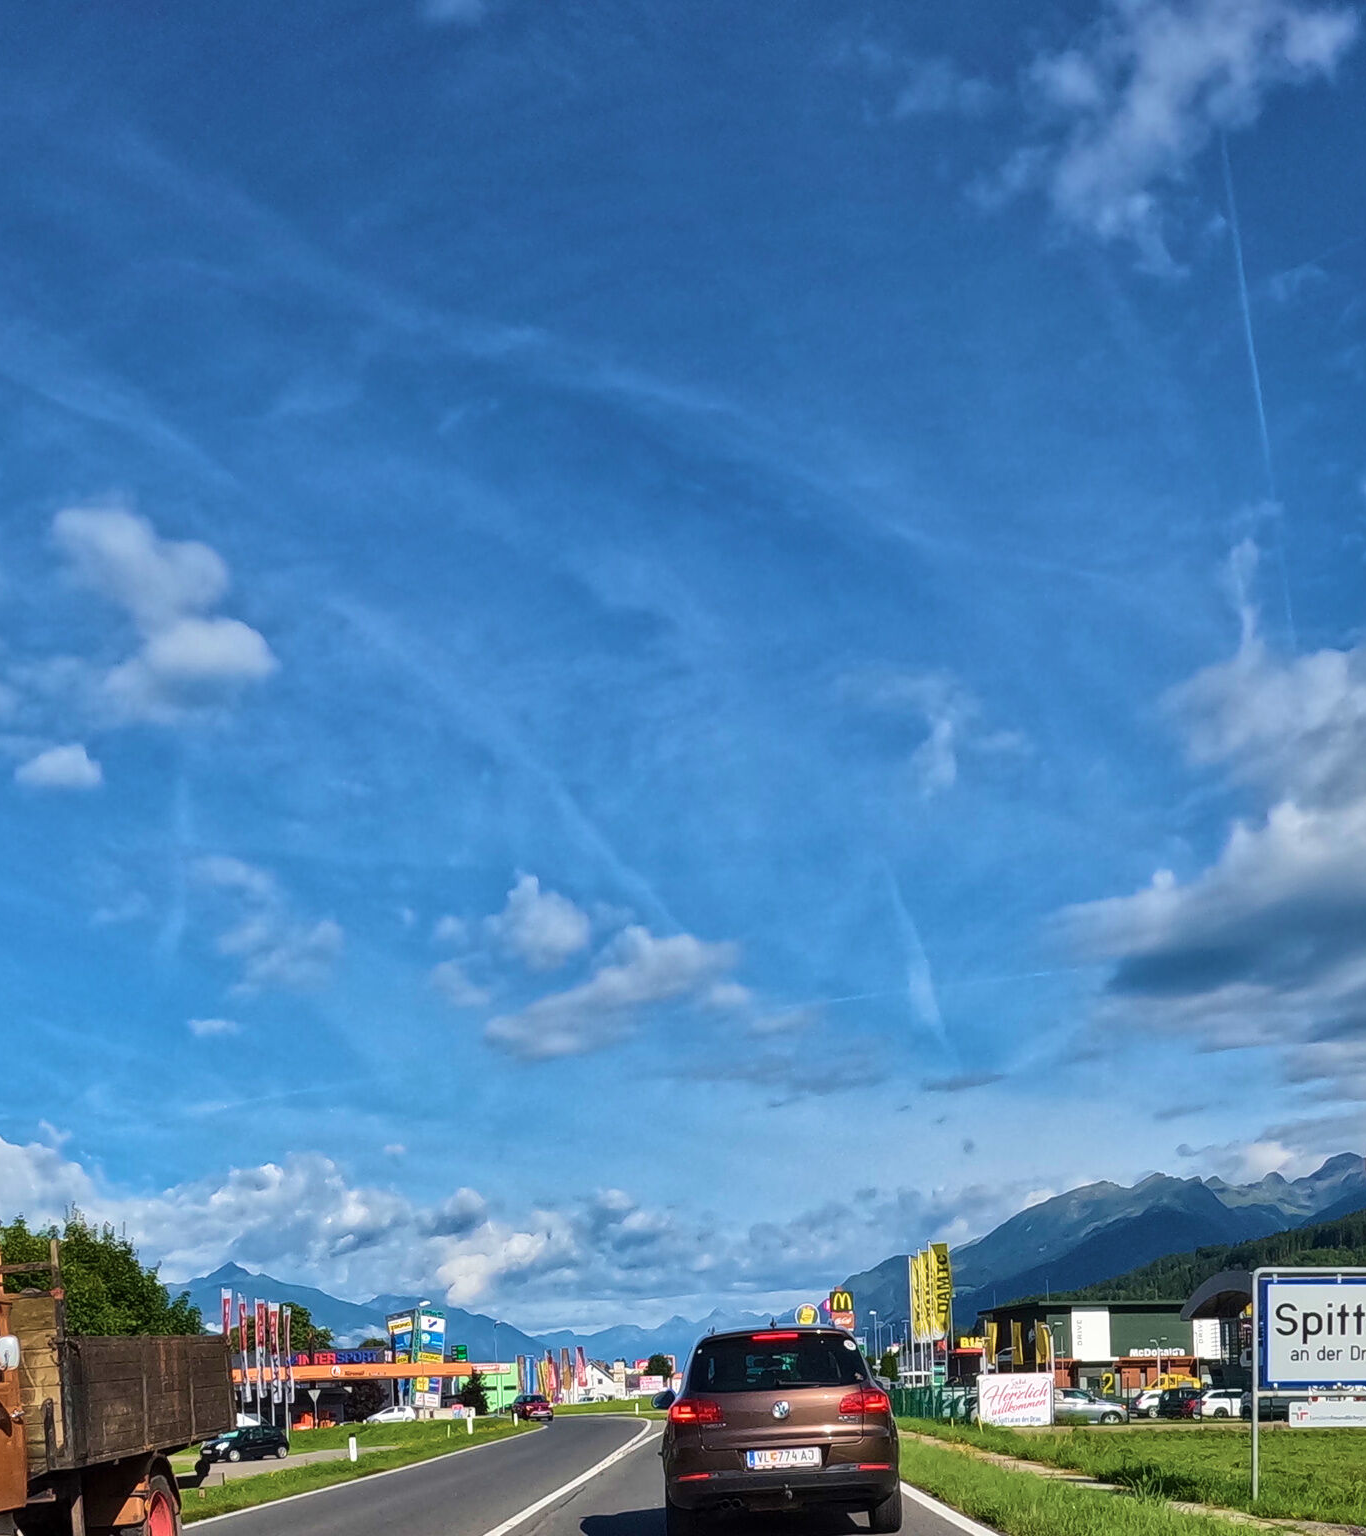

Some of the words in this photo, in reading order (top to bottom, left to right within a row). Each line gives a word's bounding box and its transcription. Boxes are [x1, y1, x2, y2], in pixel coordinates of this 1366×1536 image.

[1290, 1349, 1309, 1361] an
[1317, 1345, 1343, 1361] der
[1102, 1372, 1114, 1394] 2
[983, 1381, 1048, 1407] Herzlich
[757, 1452, 769, 1463] VL
[778, 1451, 797, 1462] 774
